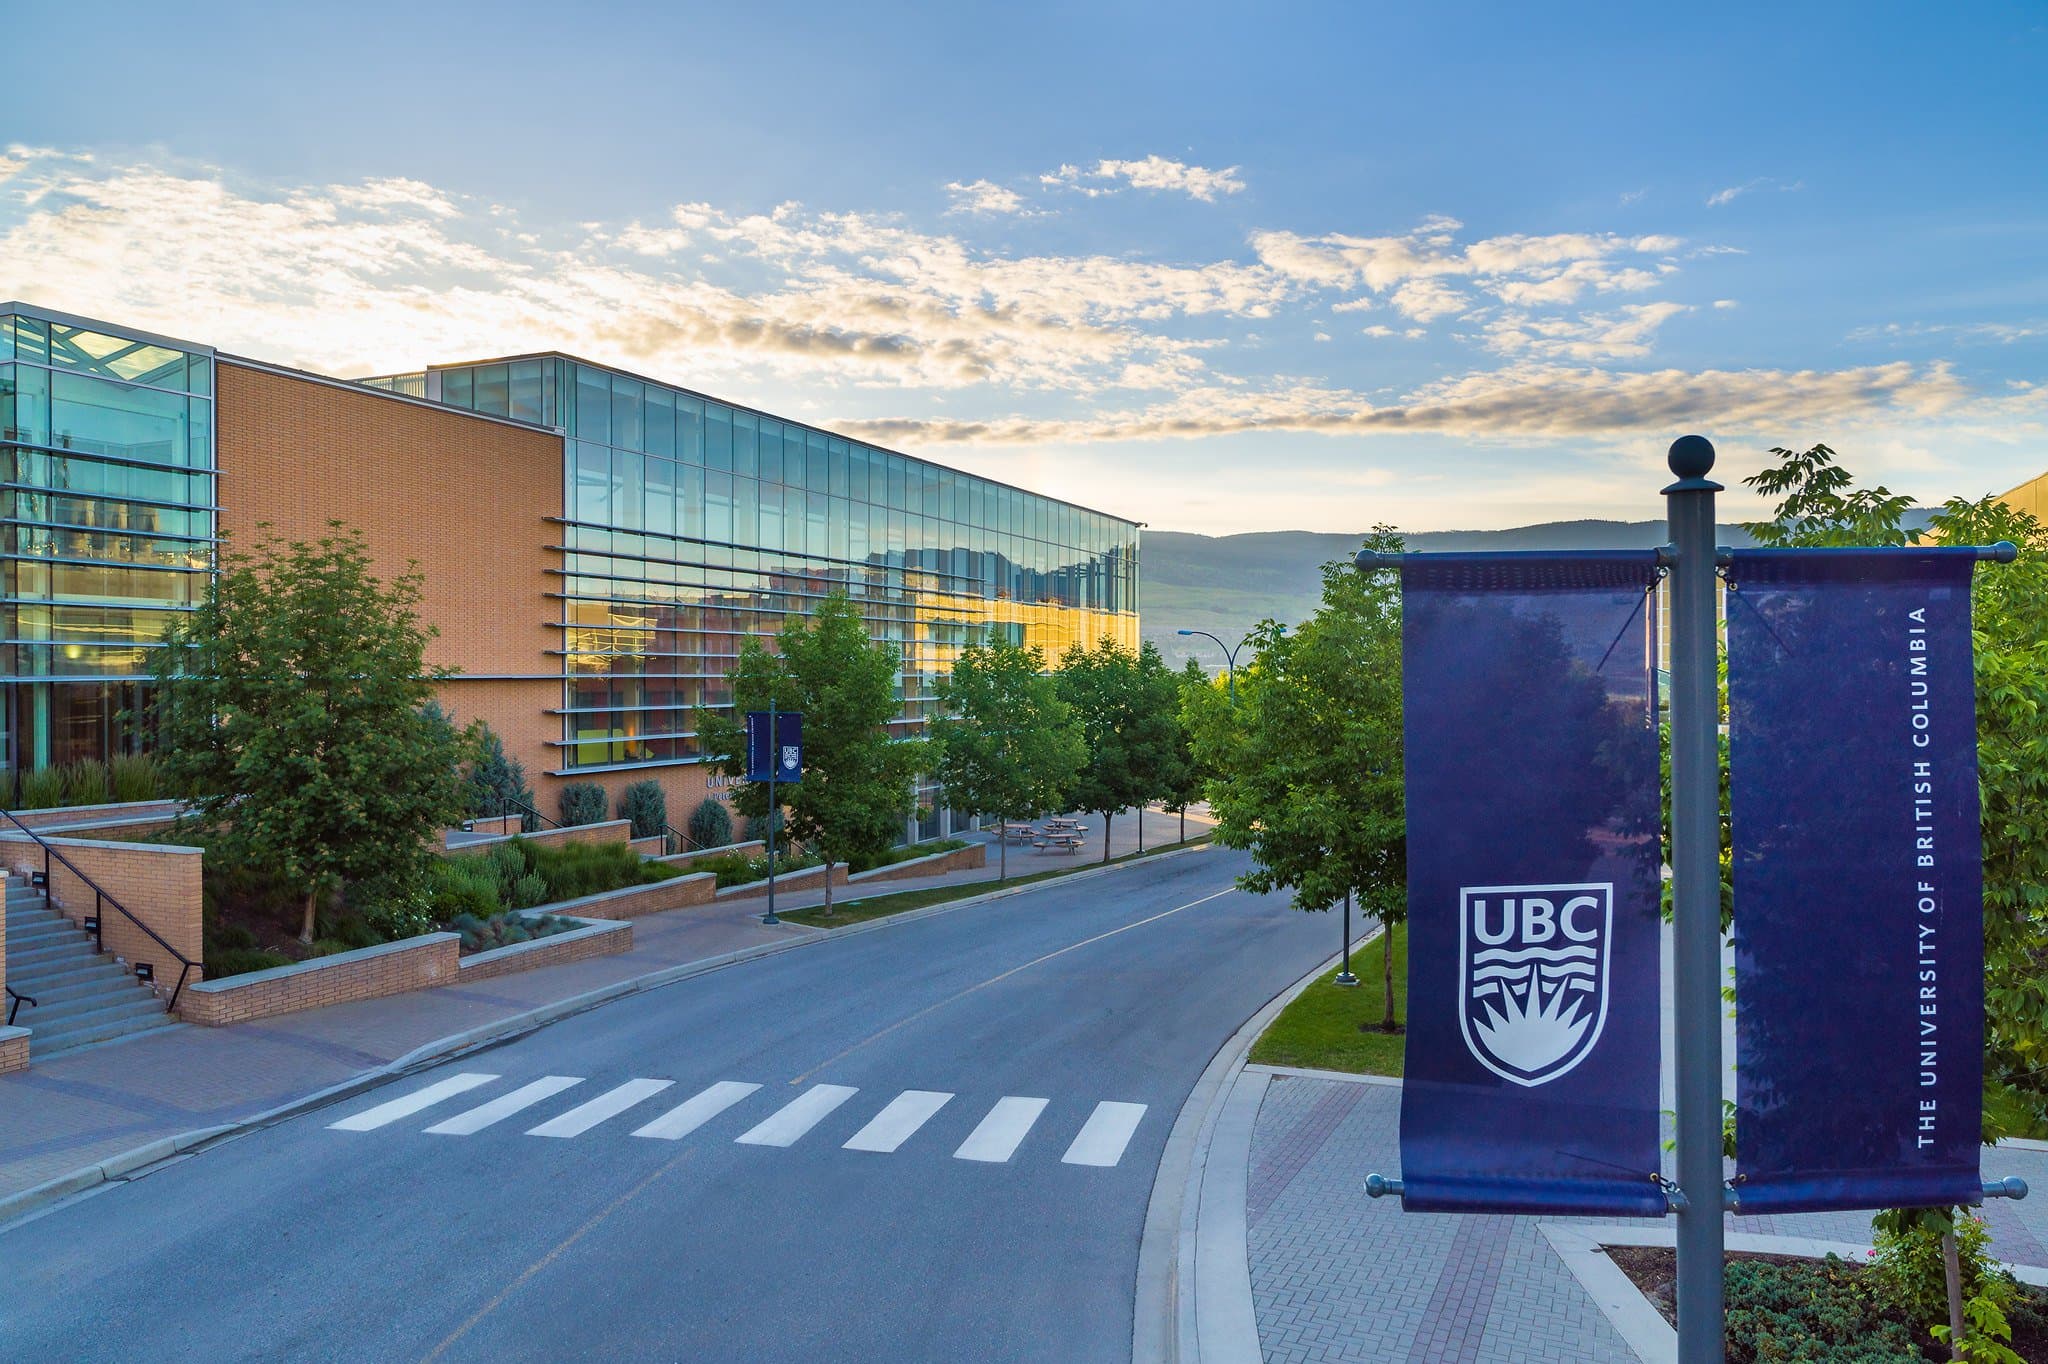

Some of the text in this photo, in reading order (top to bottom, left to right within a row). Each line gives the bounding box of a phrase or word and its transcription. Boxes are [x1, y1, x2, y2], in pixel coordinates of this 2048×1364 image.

[1474, 895, 1599, 946] UBC
[1908, 607, 1937, 1149] THE UNIVERSITY OF BRITISH COLUMBIA
